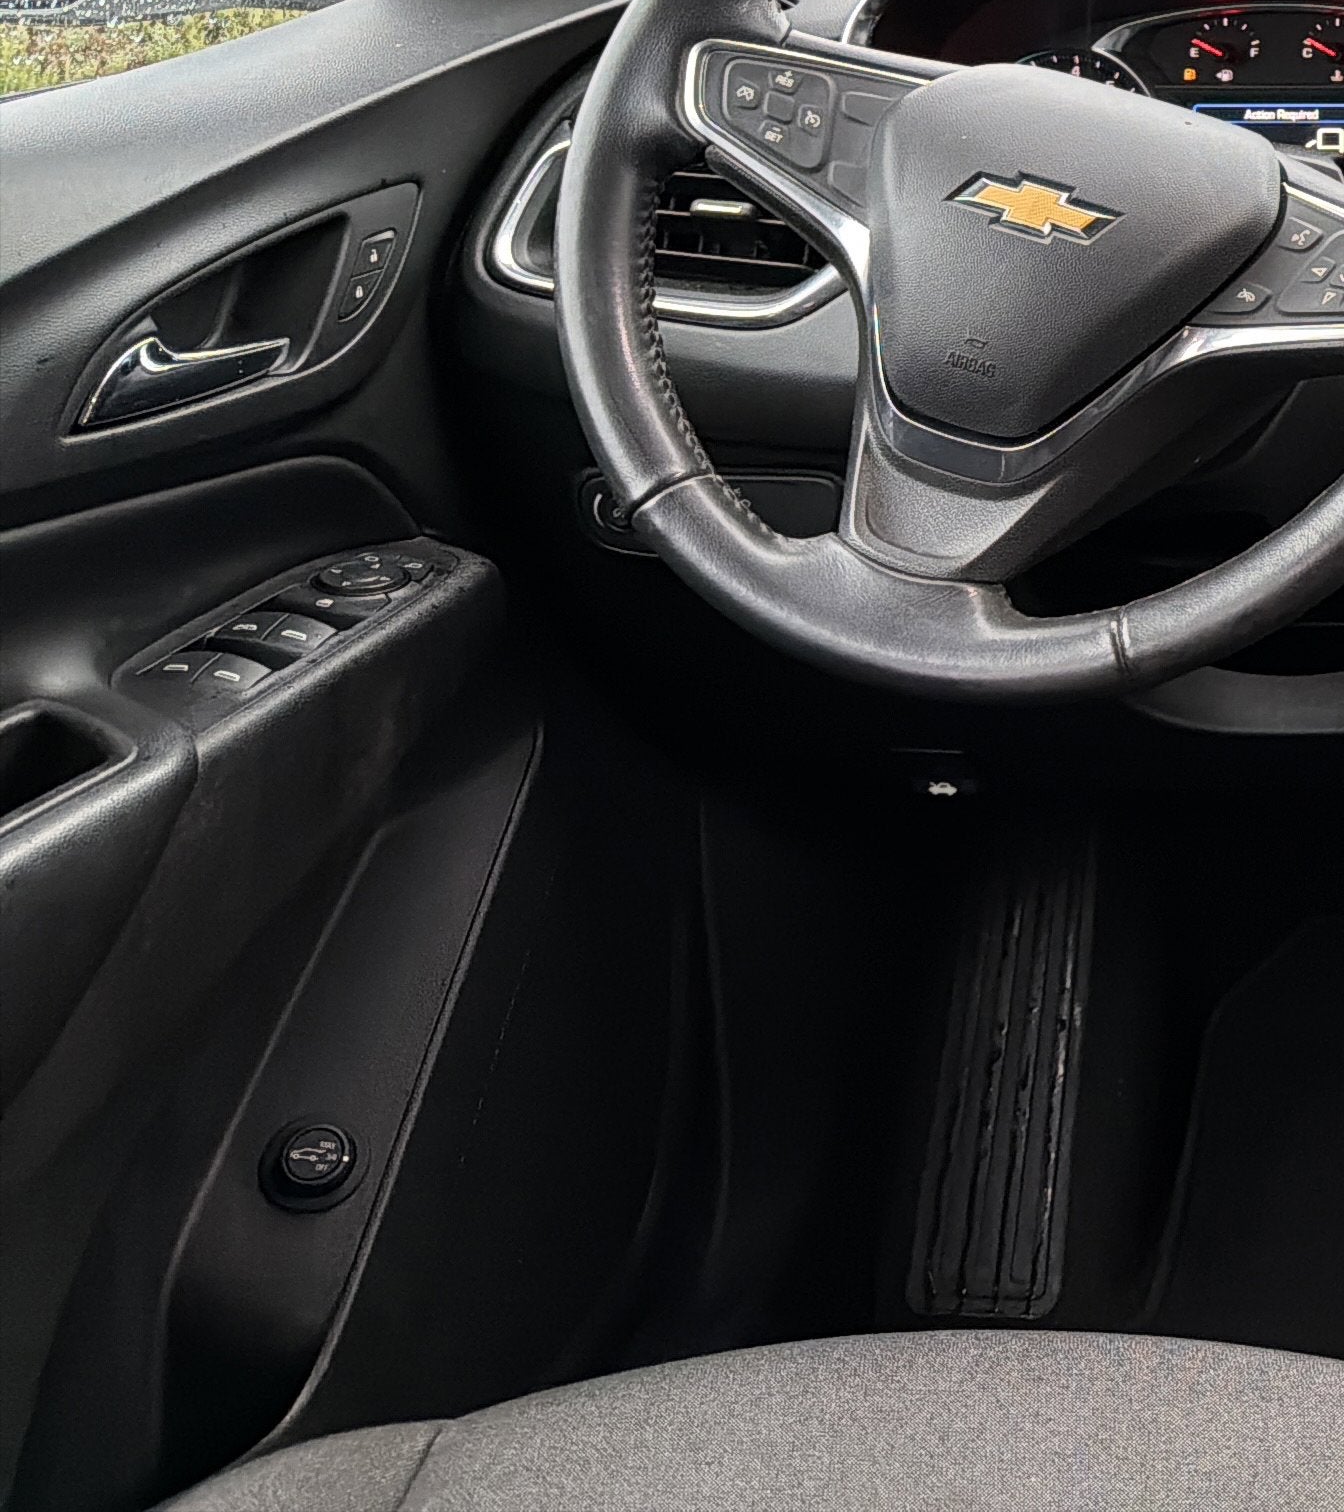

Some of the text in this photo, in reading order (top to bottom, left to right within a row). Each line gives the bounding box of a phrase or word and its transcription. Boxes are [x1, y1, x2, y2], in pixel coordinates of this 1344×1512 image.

[1189, 47, 1200, 58] E
[1250, 47, 1260, 58] F
[1302, 47, 1313, 58] C
[775, 74, 795, 88] RES
[1244, 108, 1319, 122] Action Required
[764, 130, 783, 143] SET
[942, 350, 997, 378] AIRBAG
